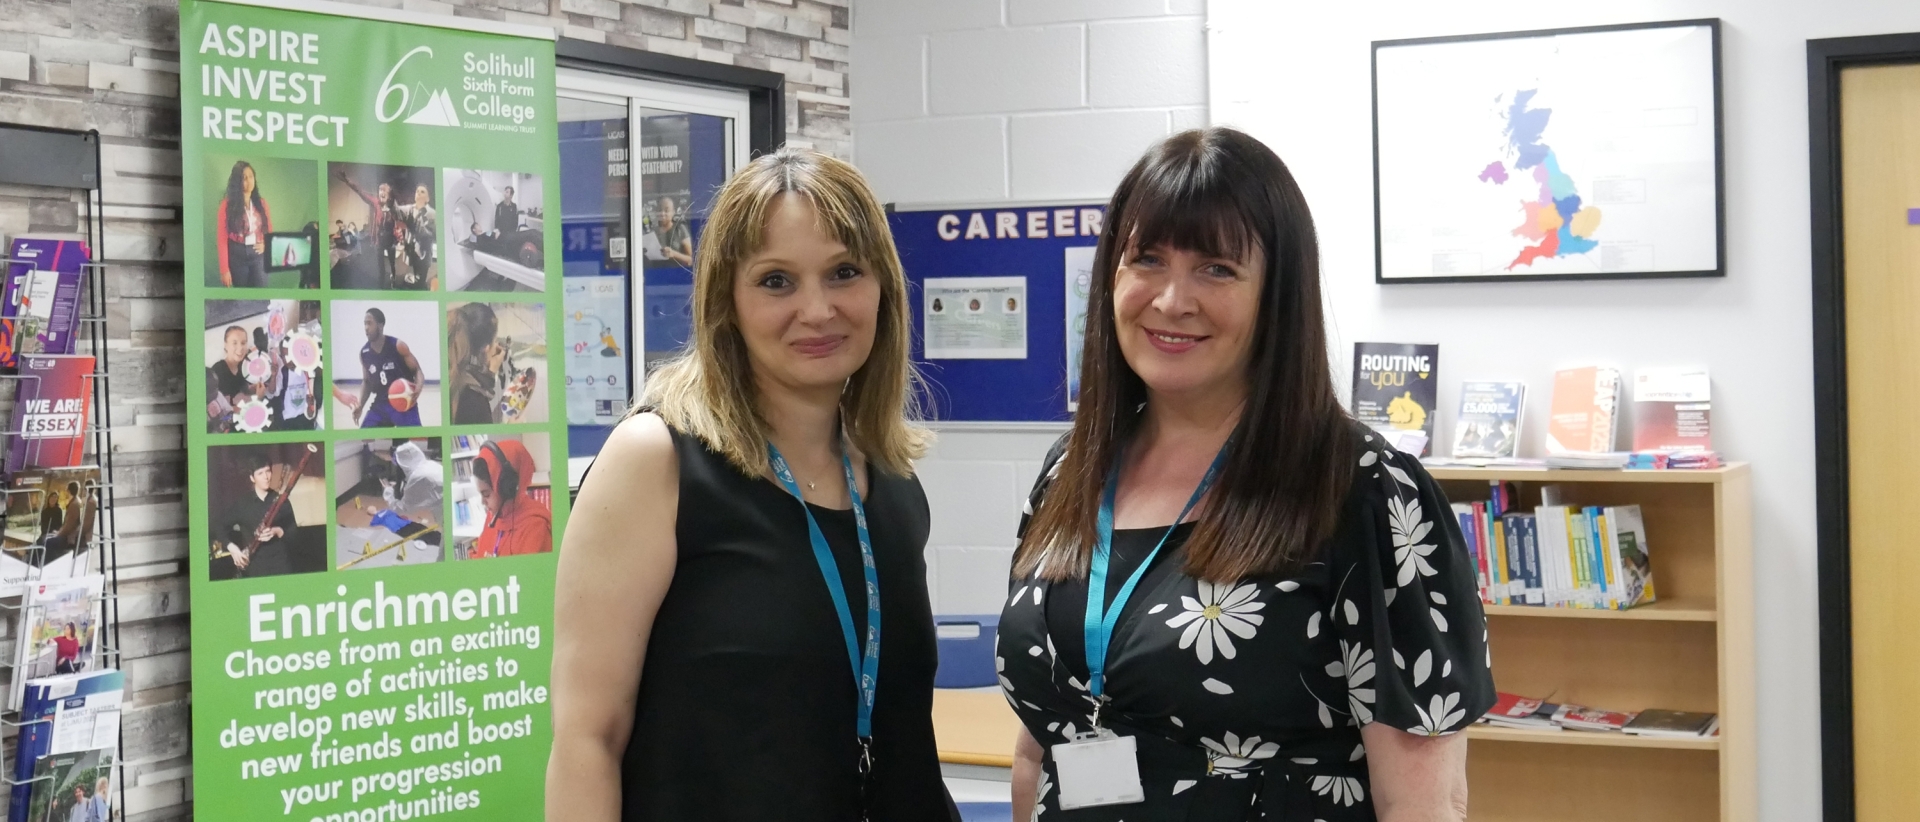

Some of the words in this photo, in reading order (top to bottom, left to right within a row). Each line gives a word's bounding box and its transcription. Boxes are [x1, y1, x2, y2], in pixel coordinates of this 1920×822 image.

[199, 22, 319, 65] ASPIRE
[463, 51, 534, 79] Solihull
[202, 64, 326, 105] INVEST
[463, 76, 496, 93] Sixth
[501, 80, 534, 97] Form
[463, 94, 535, 124] College
[202, 106, 349, 147] RESPECT
[463, 121, 487, 130] SUMMIT
[489, 123, 518, 132] LEARNING
[519, 125, 536, 134] TRUST
[608, 132, 625, 140] UCAS
[608, 148, 624, 162] NEED
[641, 146, 659, 160] WITH
[659, 145, 679, 158] YOUR
[608, 163, 628, 177] PERSO
[641, 160, 683, 175] STATEMENT?
[937, 208, 1103, 241] CAREER
[595, 284, 614, 293] UCAS
[1361, 354, 1430, 372] ROUTING
[379, 370, 388, 386] 8
[1360, 371, 1371, 380] for
[1371, 371, 1405, 390] you
[26, 399, 51, 413] WE
[53, 398, 83, 413] ARE
[1463, 402, 1498, 414] £5,000
[26, 419, 76, 432] ESSEX
[249, 575, 521, 642] Enrichment
[224, 649, 331, 679] Choose
[340, 638, 401, 666] from
[410, 635, 443, 658] an
[451, 621, 540, 653] exciting
[255, 681, 337, 710] range
[345, 669, 371, 698] of
[380, 658, 489, 693] activities
[495, 656, 519, 679] to
[219, 711, 333, 749] develop
[341, 705, 397, 732] new
[405, 690, 475, 723] skills,
[483, 680, 548, 711] make
[241, 752, 302, 780] new
[310, 731, 402, 769] friends
[410, 721, 459, 754] and
[468, 714, 533, 745] boost
[280, 777, 343, 815] your
[352, 751, 502, 803] progression
